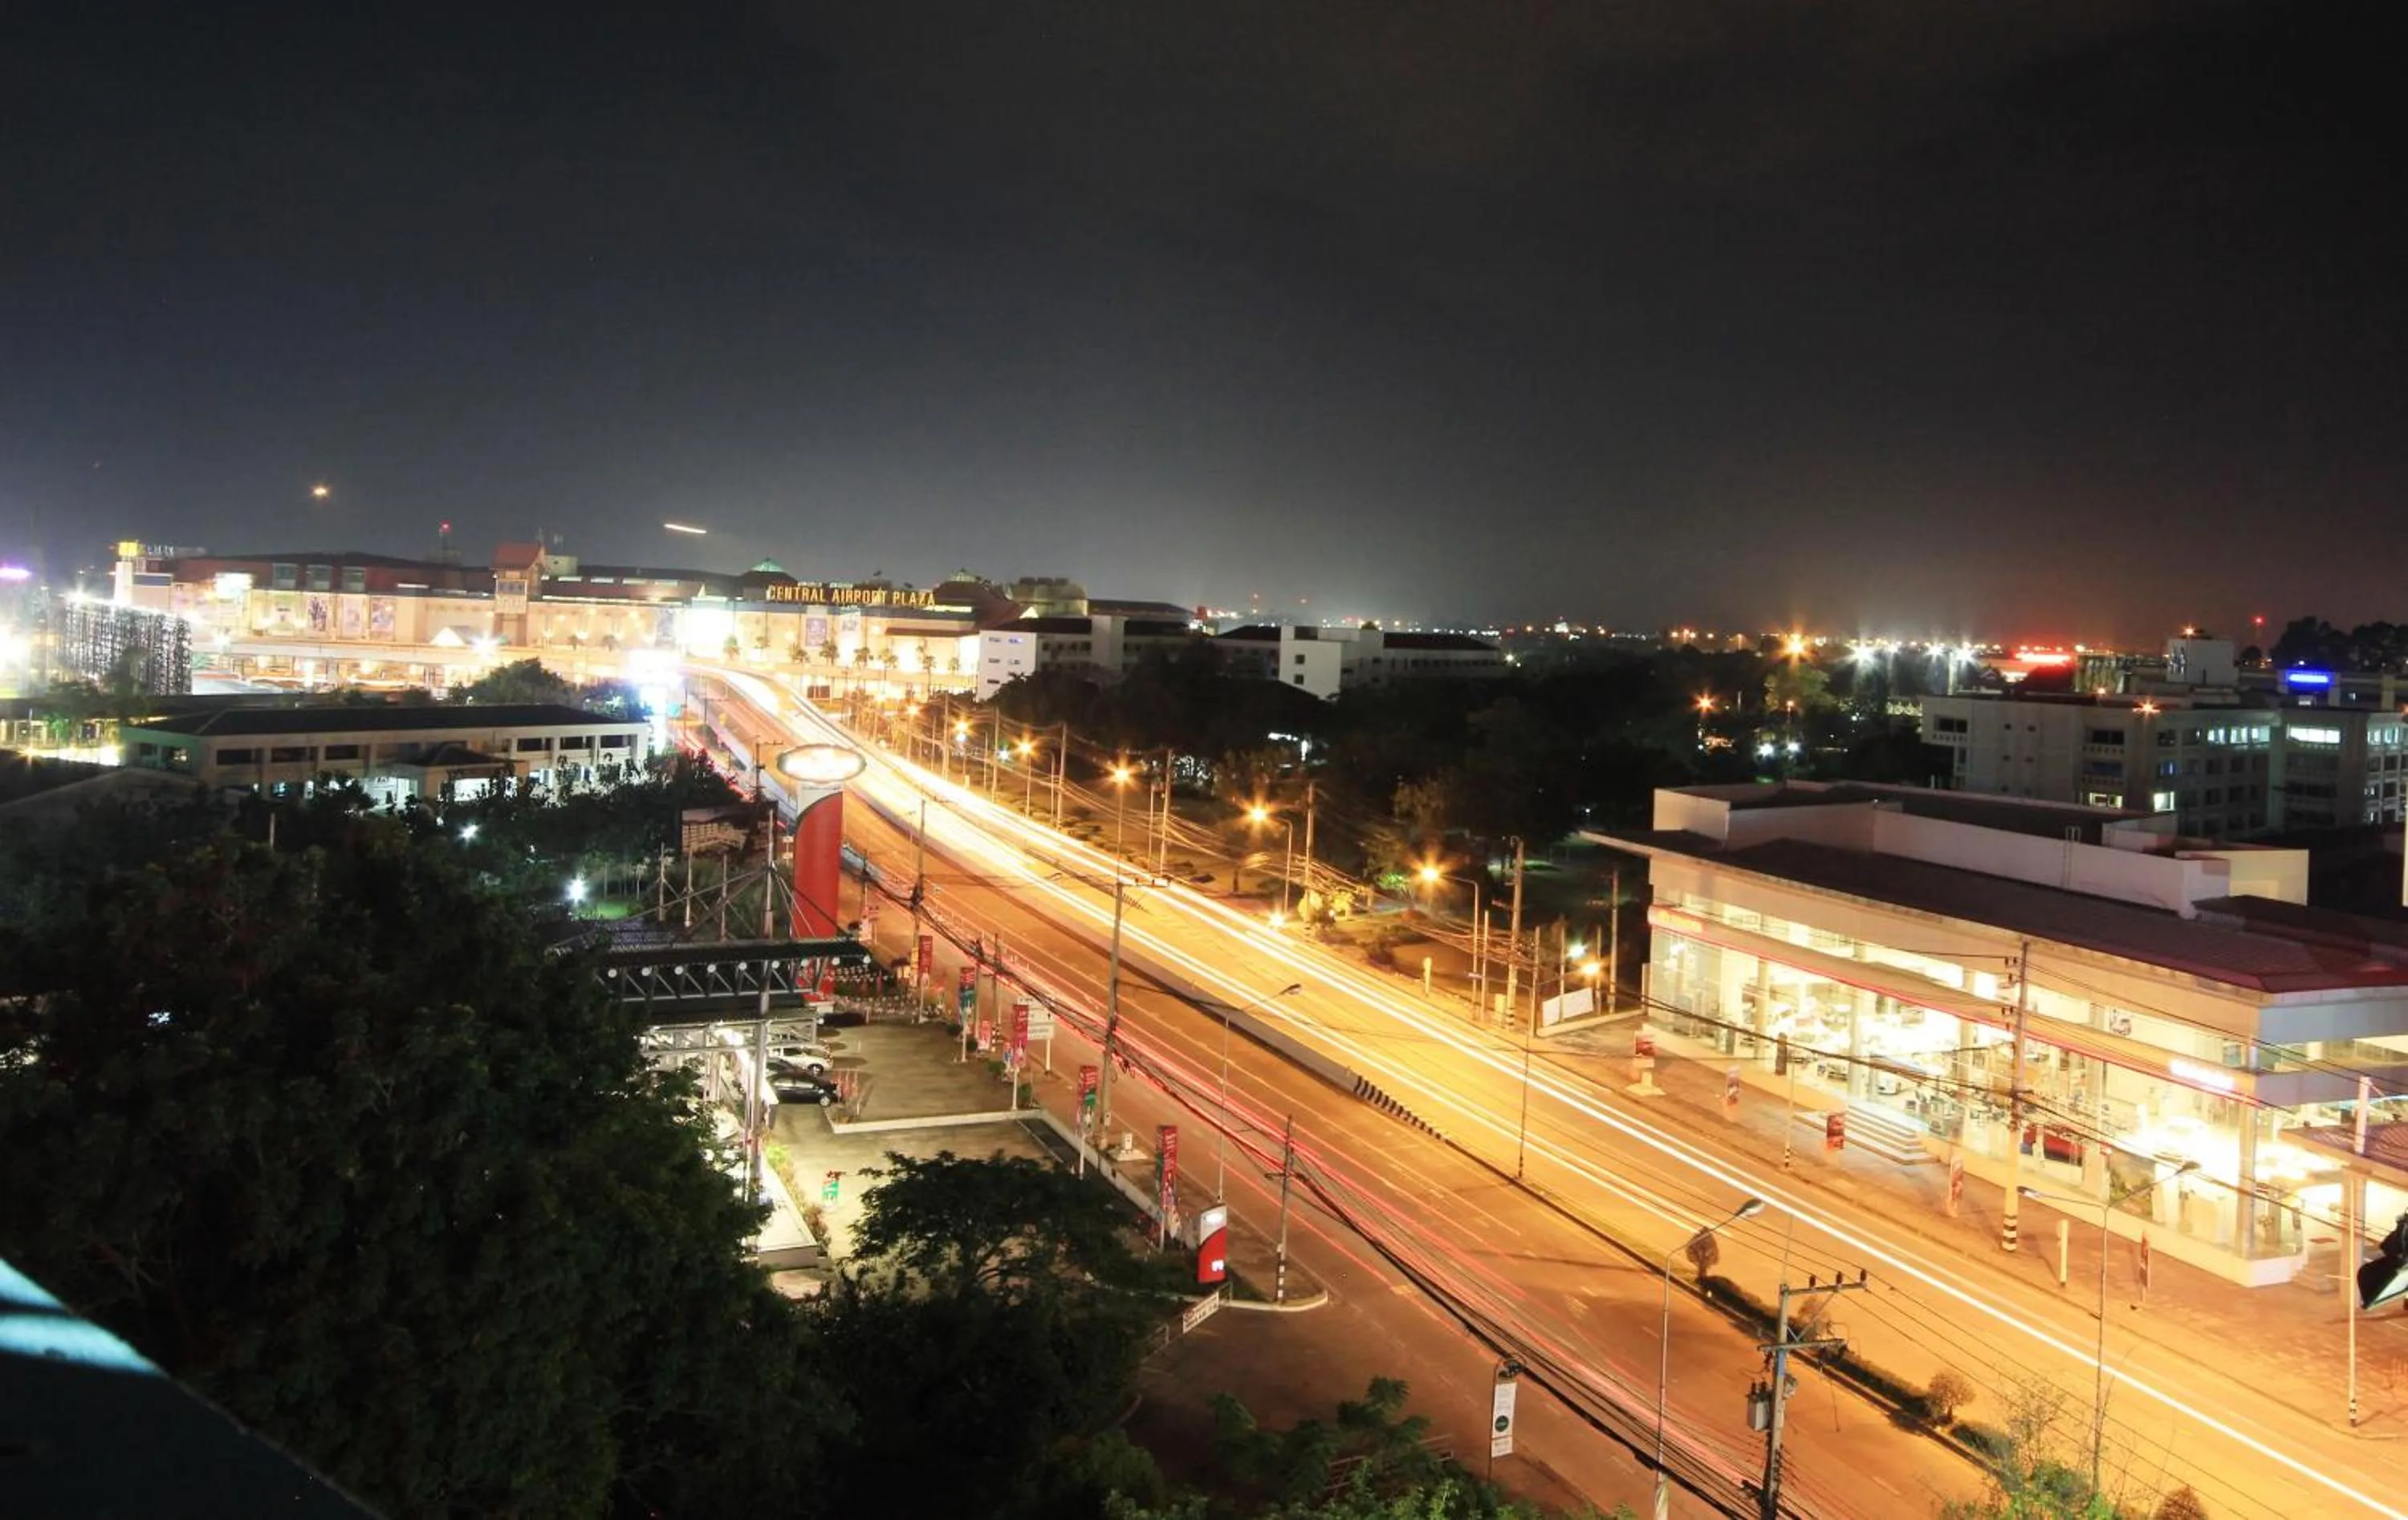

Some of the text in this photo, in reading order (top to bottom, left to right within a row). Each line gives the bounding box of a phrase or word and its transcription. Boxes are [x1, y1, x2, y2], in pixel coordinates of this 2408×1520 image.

[767, 584, 935, 606] CENTRAL AIRPORT PLAZA
